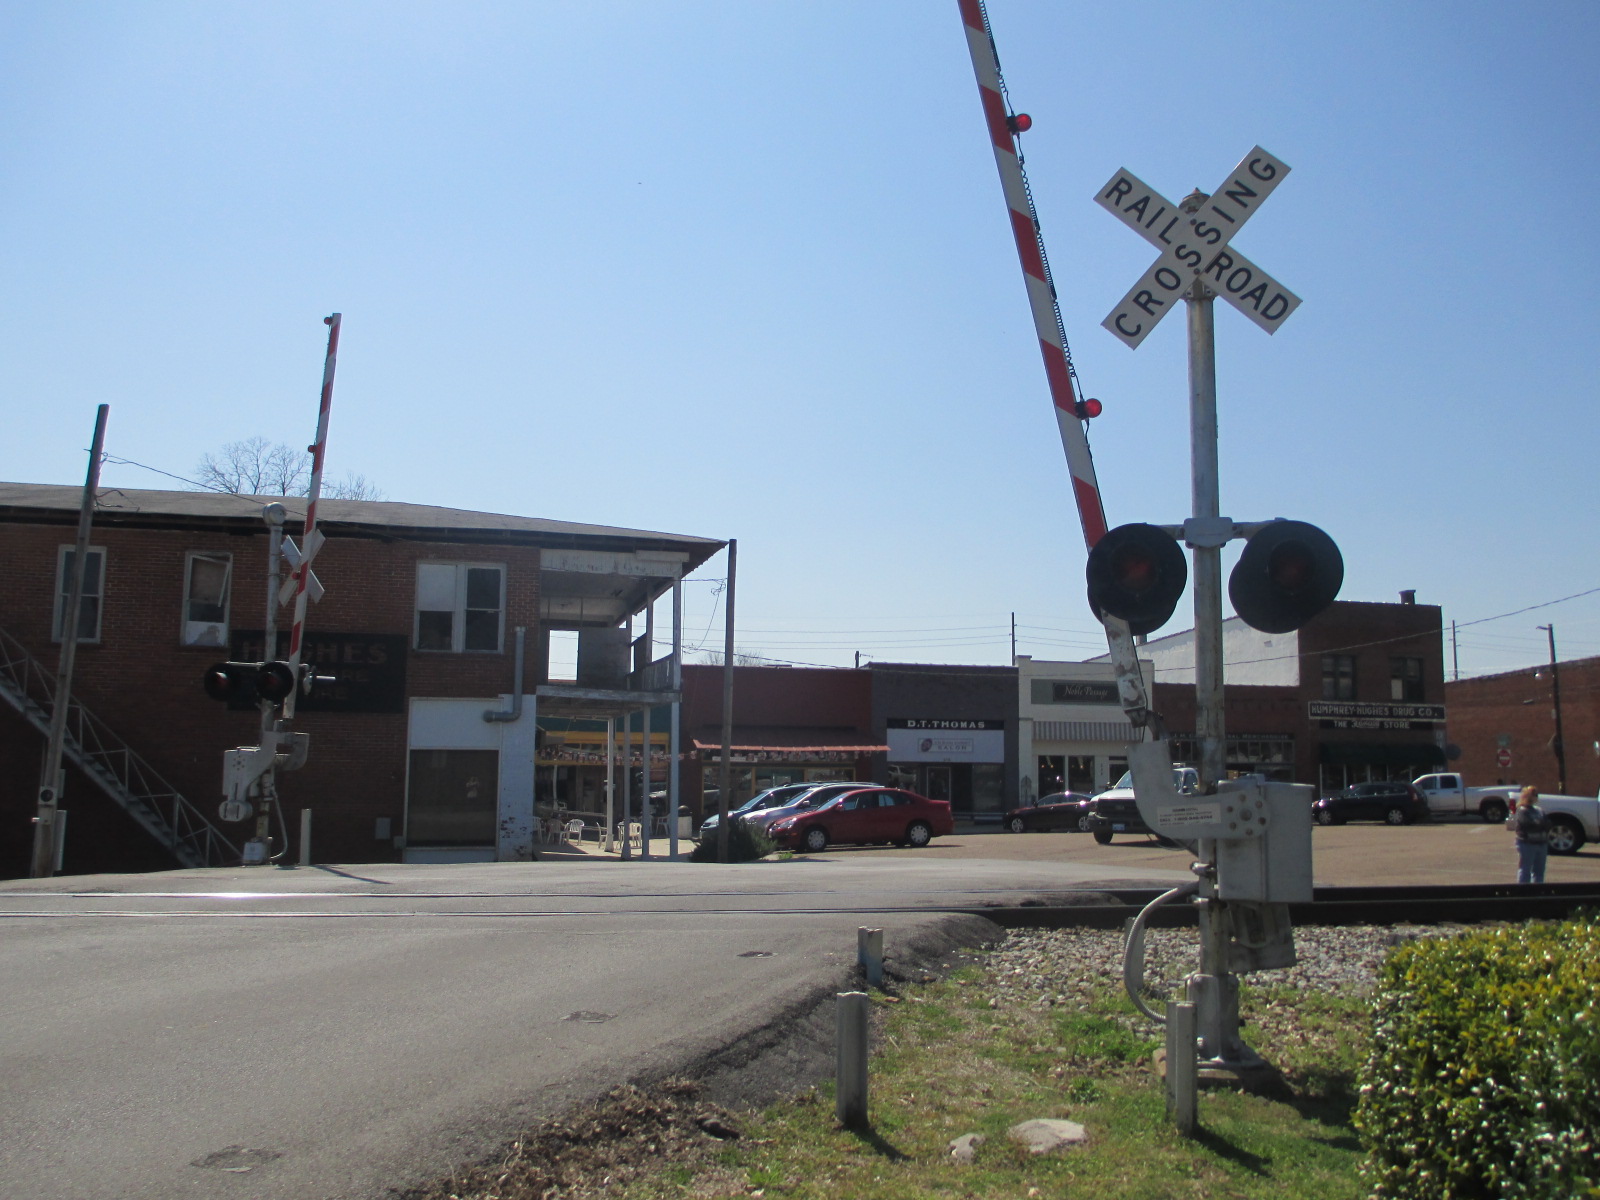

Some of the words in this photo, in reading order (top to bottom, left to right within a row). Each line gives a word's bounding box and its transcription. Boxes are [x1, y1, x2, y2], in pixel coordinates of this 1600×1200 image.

[1115, 158, 1276, 337] CROSSING
[1392, 707, 1415, 717] DRUG
[1418, 707, 1438, 717] CO.
[1384, 721, 1410, 729] STORE
